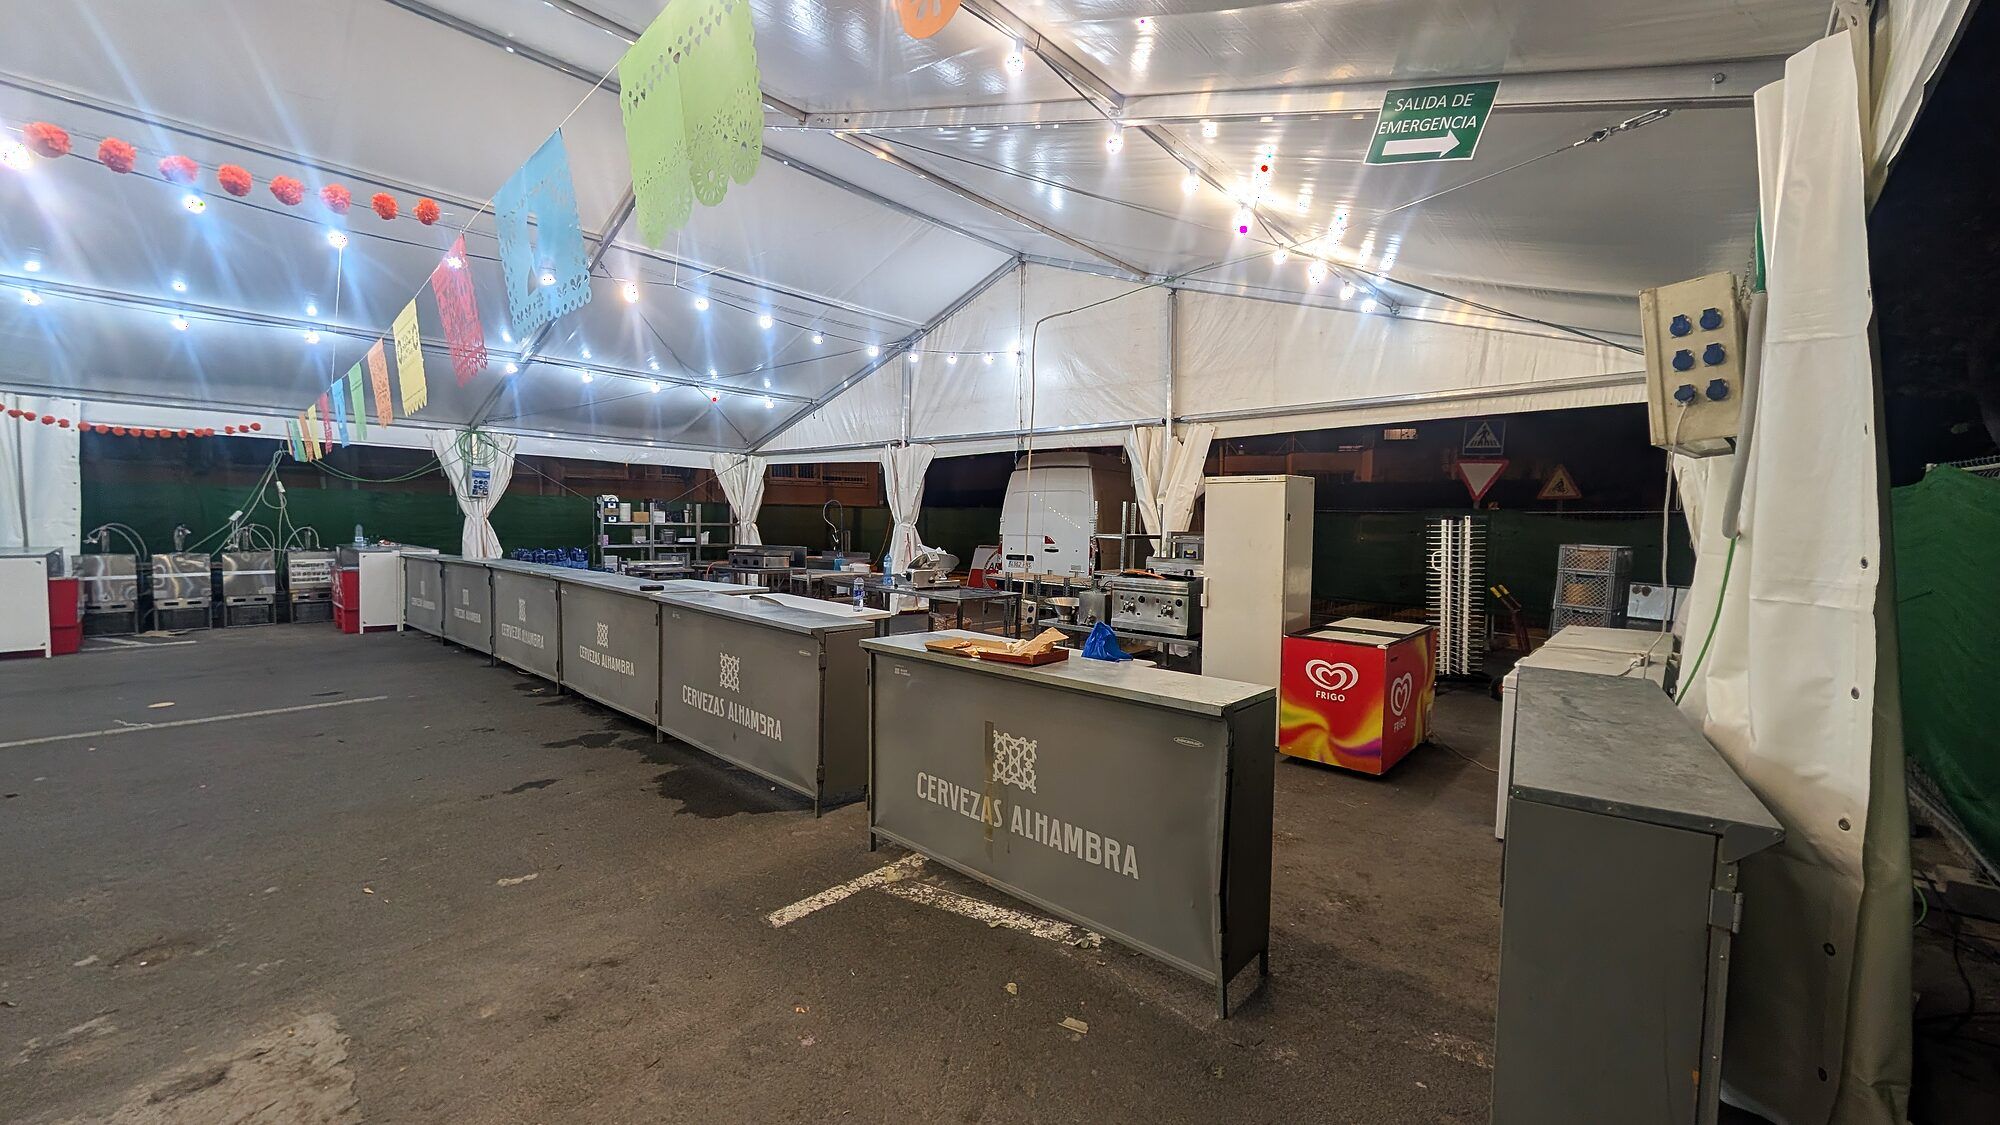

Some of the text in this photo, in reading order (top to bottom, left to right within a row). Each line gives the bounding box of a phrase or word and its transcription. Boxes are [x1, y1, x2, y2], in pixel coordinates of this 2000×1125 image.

[1394, 93, 1475, 112] SALIDA DE
[1378, 115, 1477, 135] EMERGENCIA
[579, 645, 635, 677] CERVEZAS ALHAMBRA
[1315, 690, 1346, 702] FRIGO
[682, 684, 782, 742] CERVEZAS ALHAMBRA
[916, 771, 1140, 881] CERVEZAS ALHAMBRA
